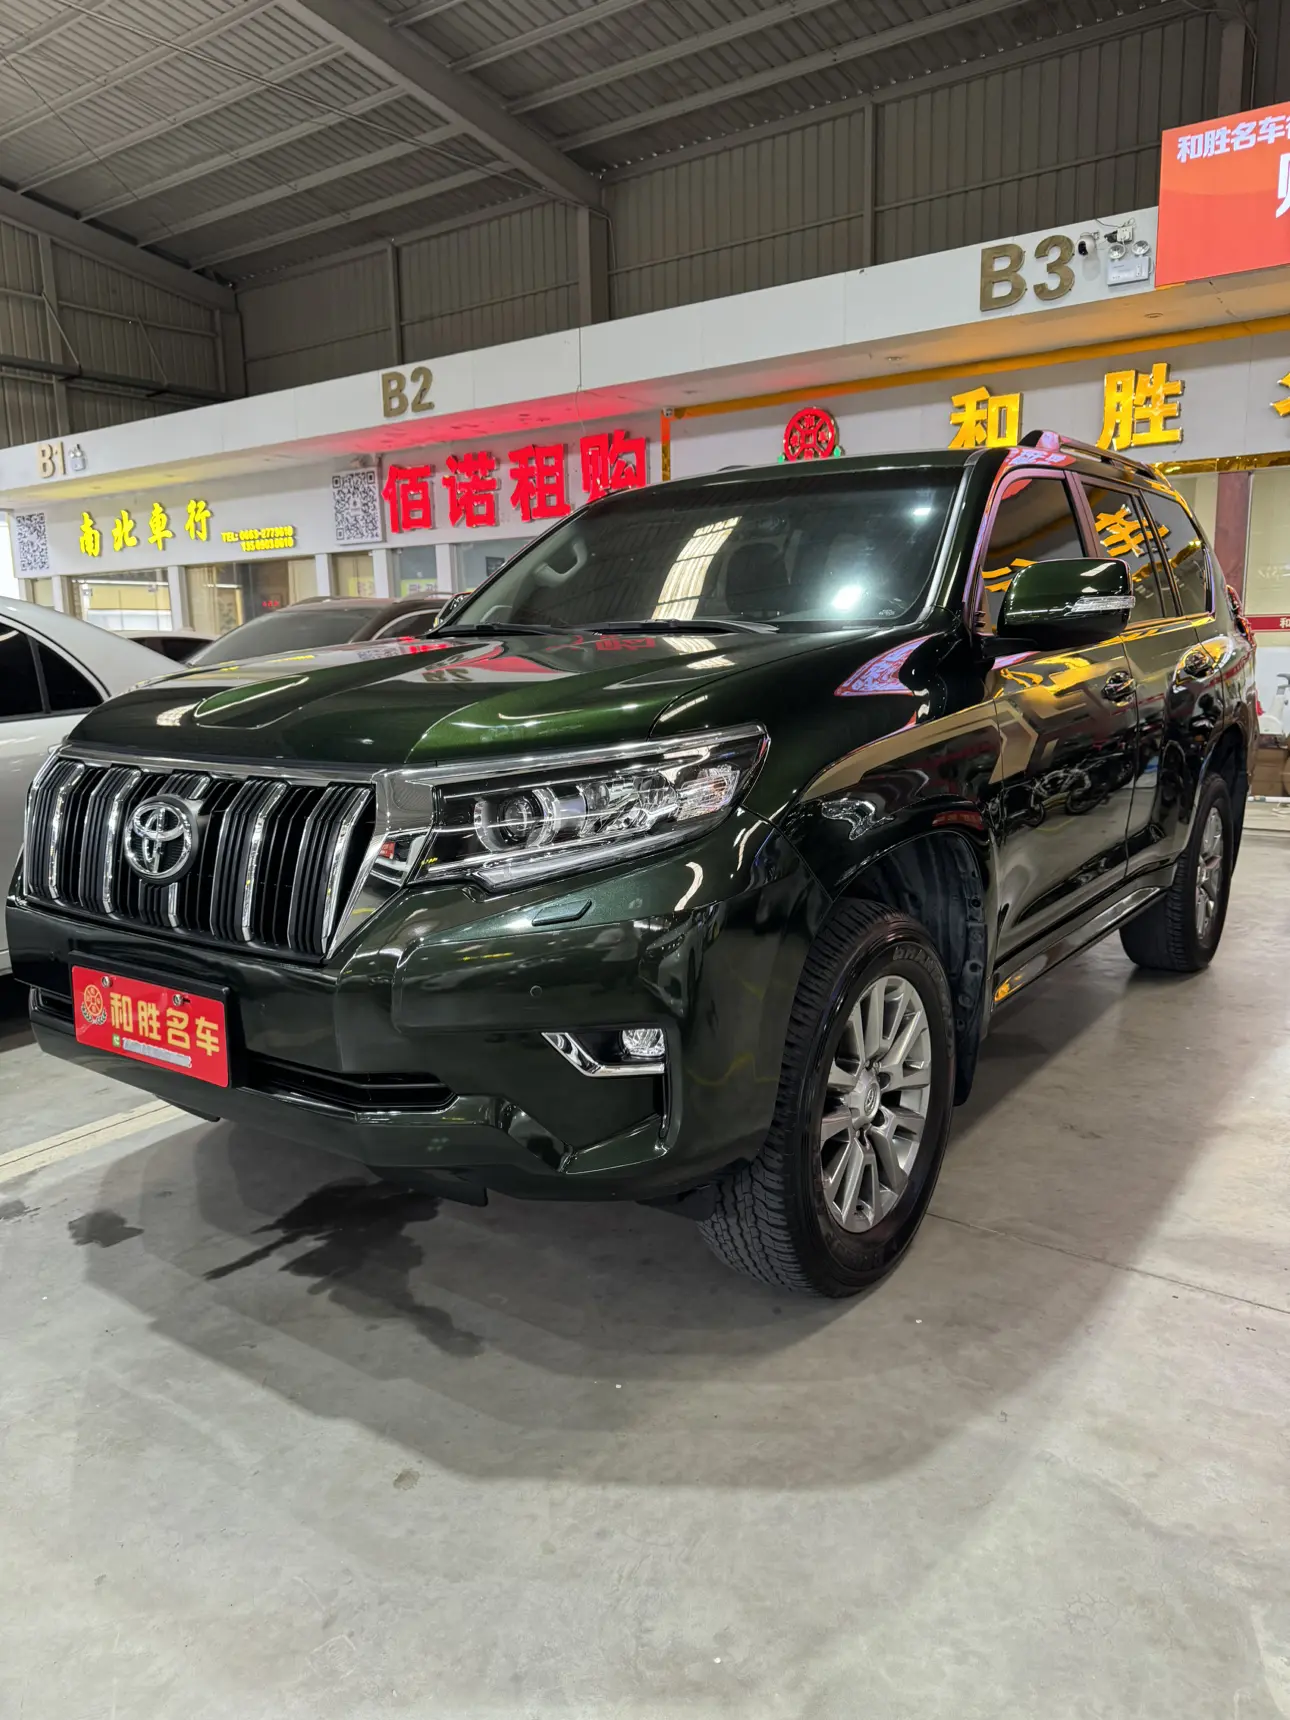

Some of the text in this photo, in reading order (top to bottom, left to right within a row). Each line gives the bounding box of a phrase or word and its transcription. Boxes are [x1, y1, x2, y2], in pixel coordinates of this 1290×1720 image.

[1177, 115, 1290, 163] 和胜名车
[980, 234, 1075, 312] B3
[381, 366, 435, 418] B2
[949, 363, 1290, 451] 和胜
[37, 441, 67, 479] B1
[381, 429, 648, 533] 佰诺租购
[109, 991, 220, 1057] 和胜名车
